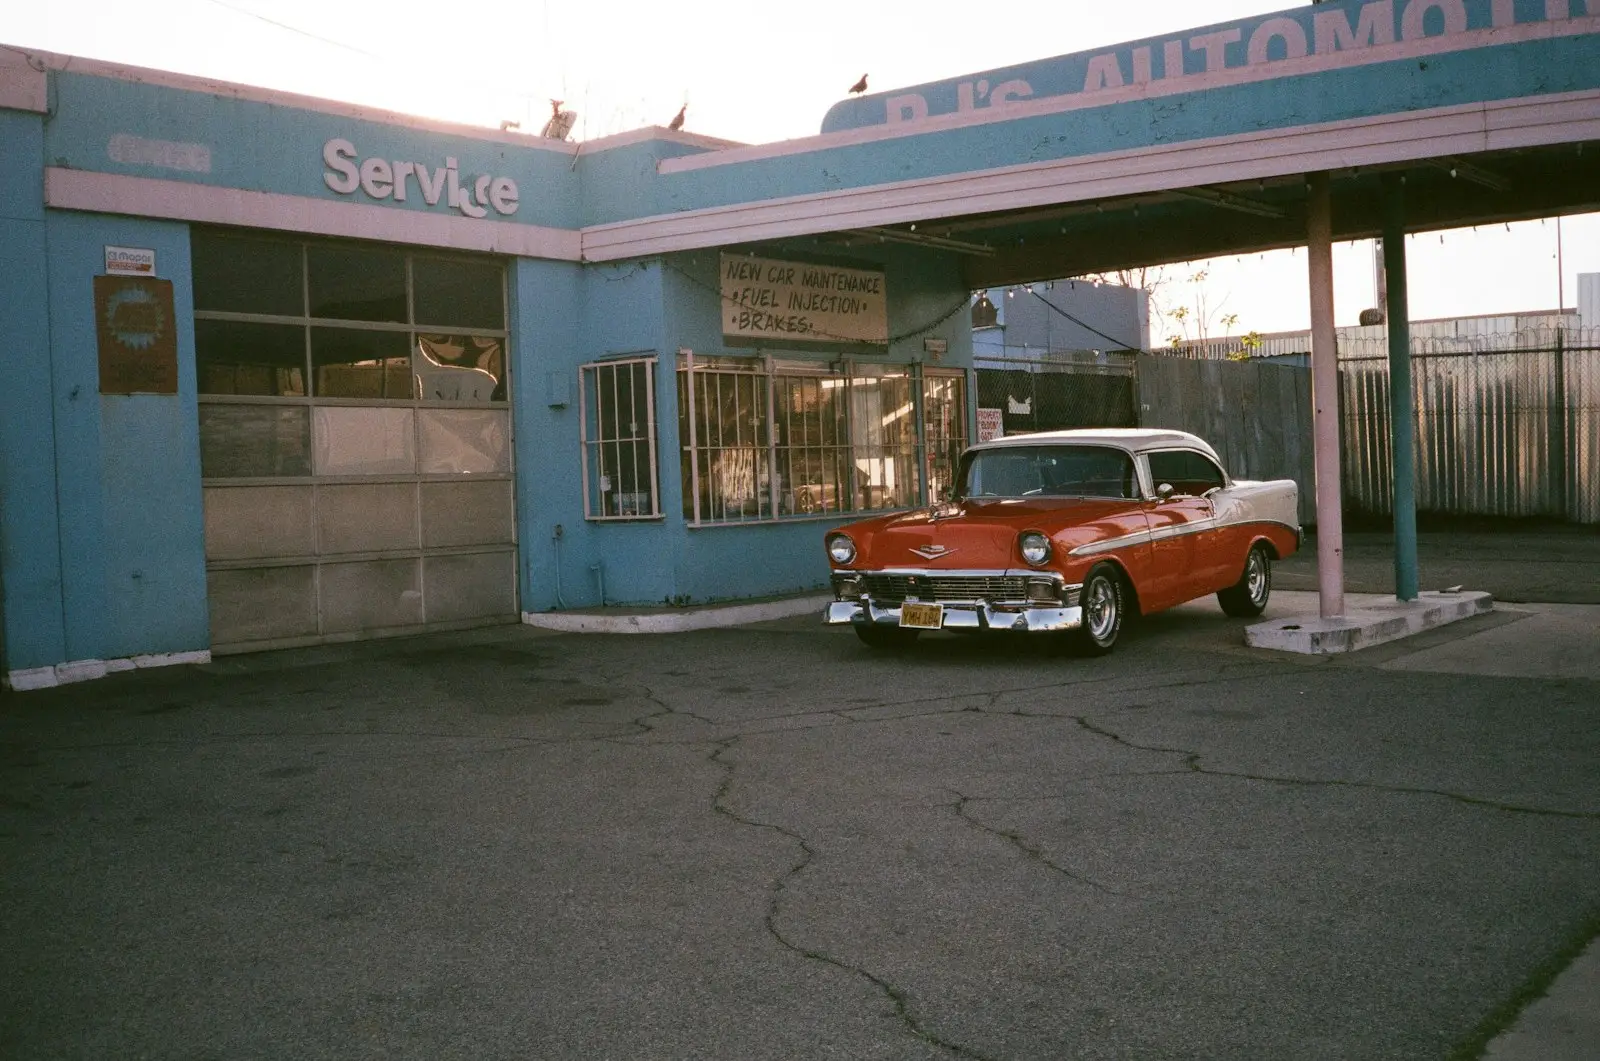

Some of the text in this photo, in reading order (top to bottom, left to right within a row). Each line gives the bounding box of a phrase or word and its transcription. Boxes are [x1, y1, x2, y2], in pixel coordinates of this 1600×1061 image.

[323, 138, 520, 218] Service
[726, 260, 881, 294] NEW CAR MAINTENANCE
[740, 287, 861, 315] FUEL INJECTION
[738, 311, 809, 333] BRAKES
